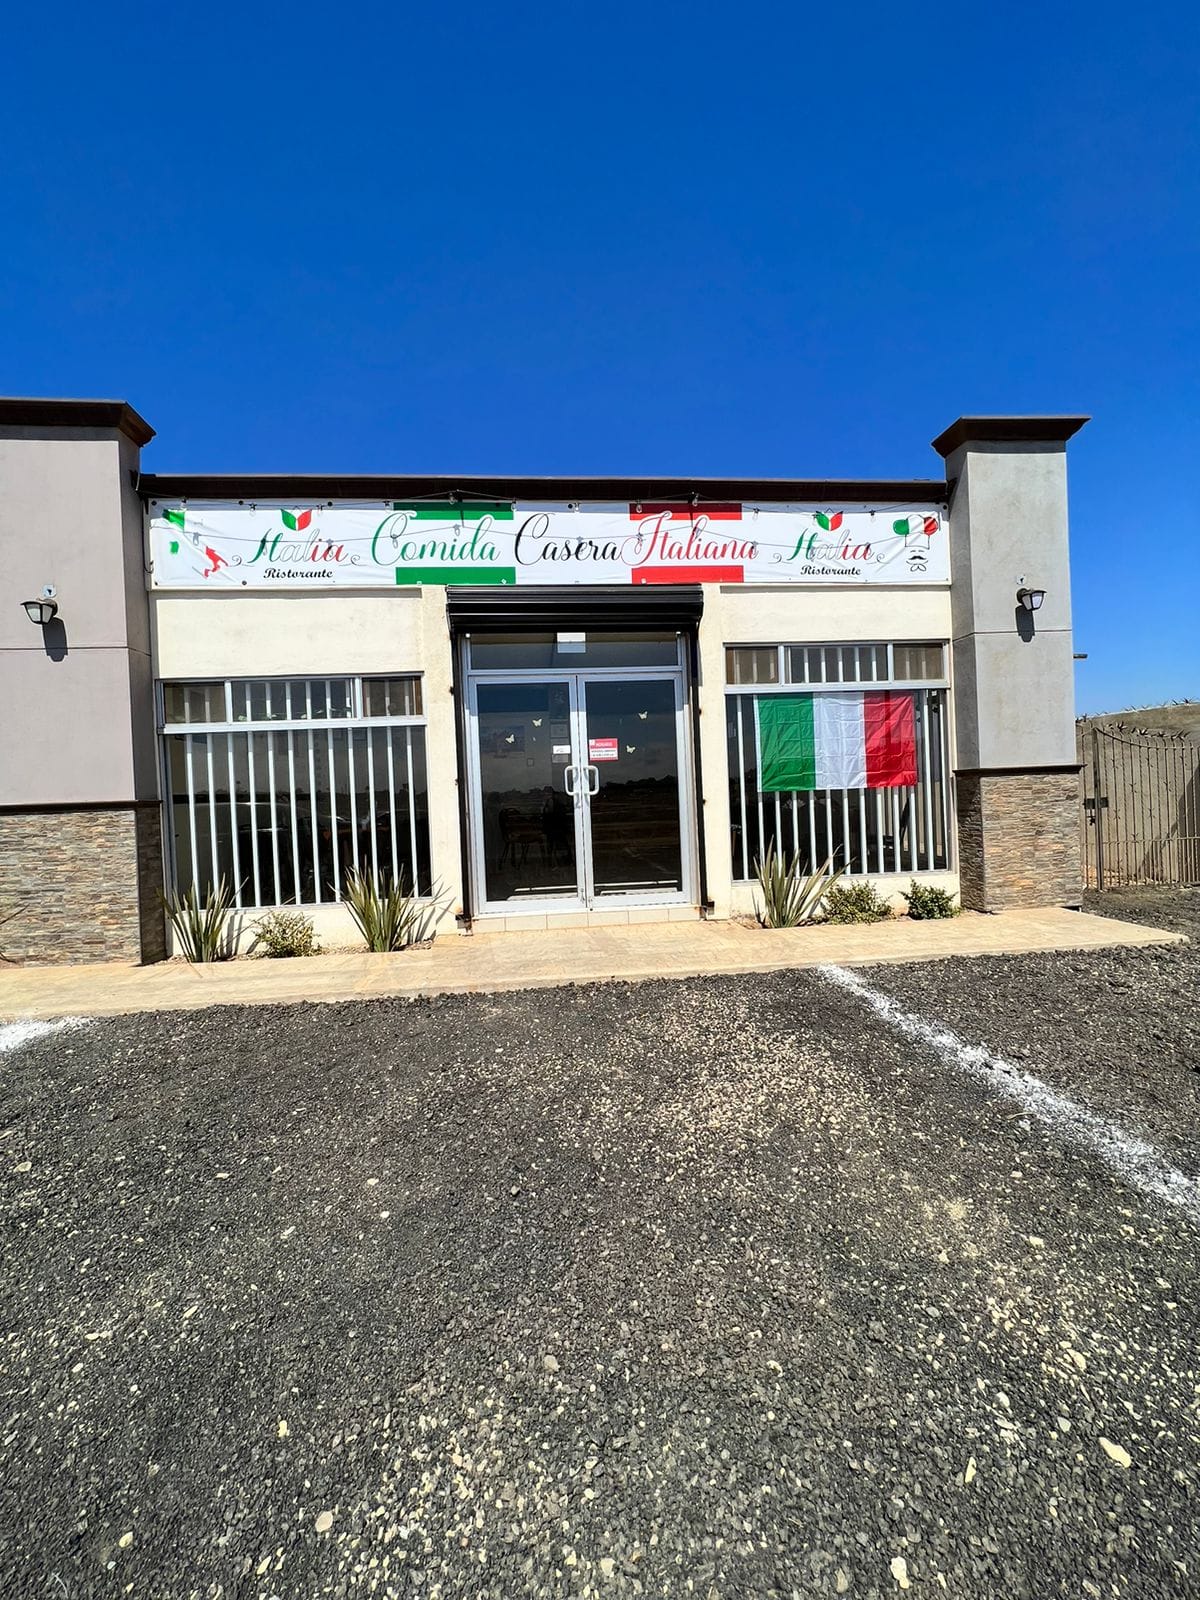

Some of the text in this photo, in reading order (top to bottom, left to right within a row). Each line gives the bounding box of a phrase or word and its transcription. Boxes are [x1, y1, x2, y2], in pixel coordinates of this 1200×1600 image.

[247, 528, 348, 562] Italia
[371, 511, 759, 566] Comida Casera Italiana
[787, 528, 874, 561] Italia
[263, 567, 333, 579] Ristorante
[800, 565, 861, 576] Ristorante
